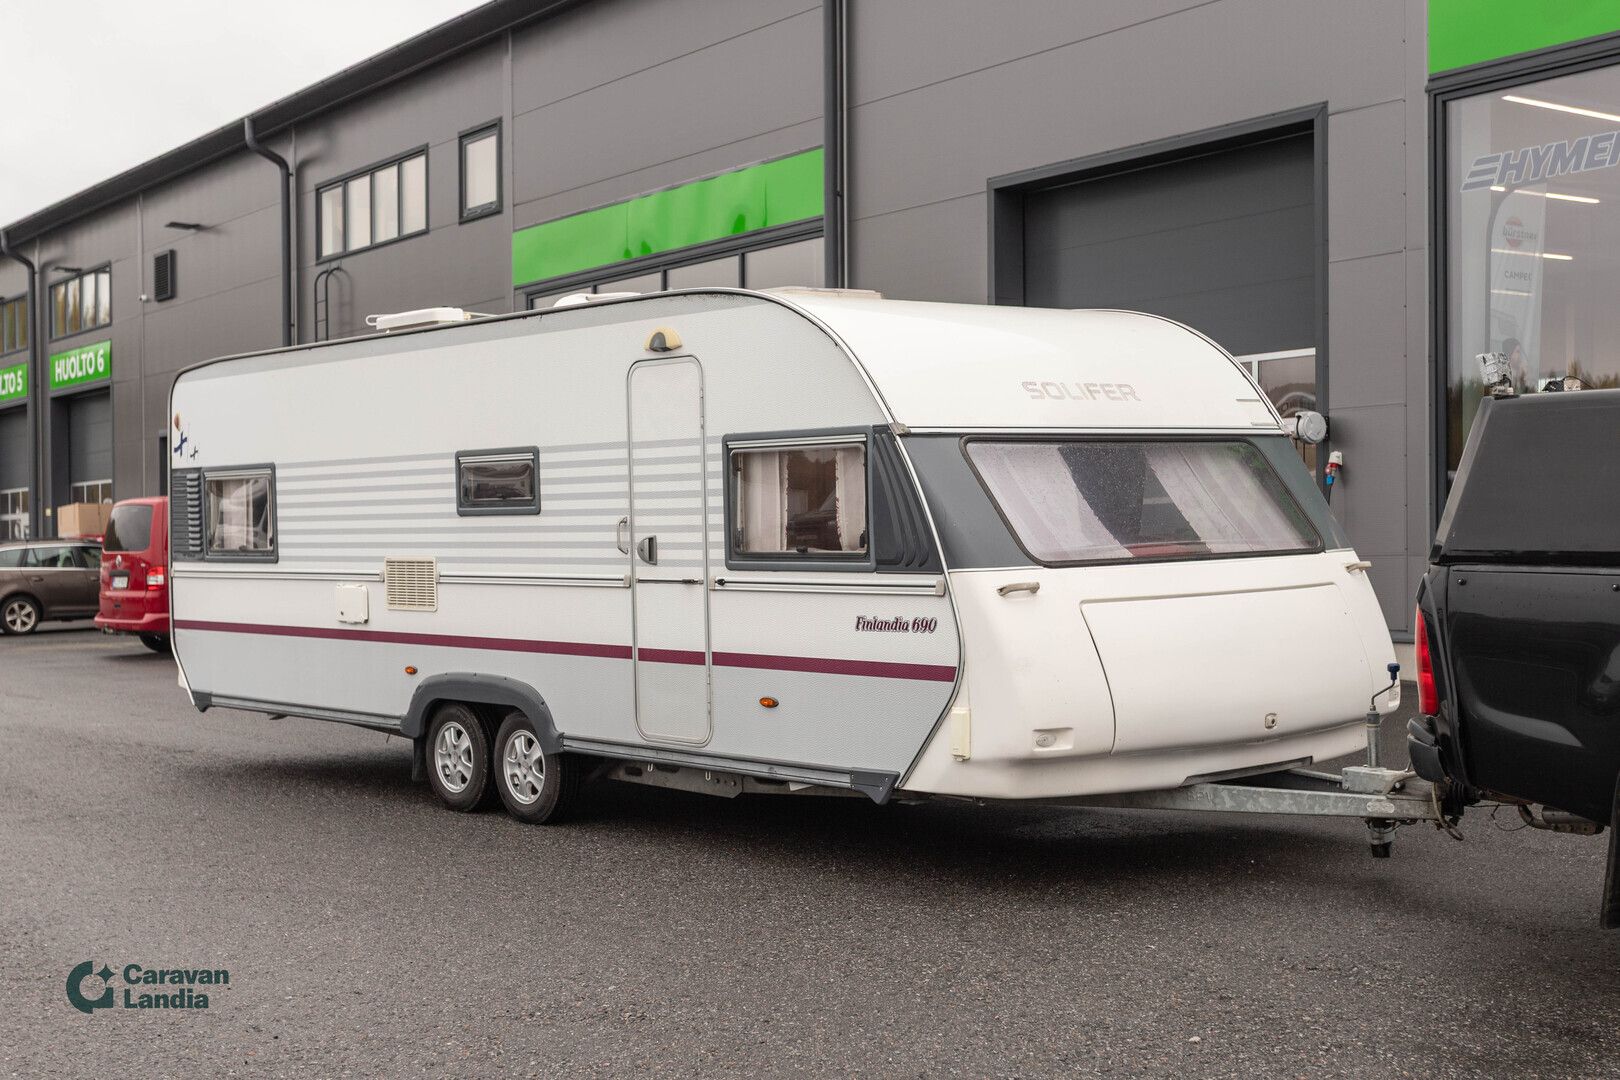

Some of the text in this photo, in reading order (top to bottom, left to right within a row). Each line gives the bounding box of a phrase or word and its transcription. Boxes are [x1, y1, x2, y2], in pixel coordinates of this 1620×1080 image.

[54, 347, 105, 383] HUOLTO 6
[17, 369, 23, 392] 5
[1021, 381, 1142, 402] SOLIFER
[855, 615, 938, 634] Finlandia 690
